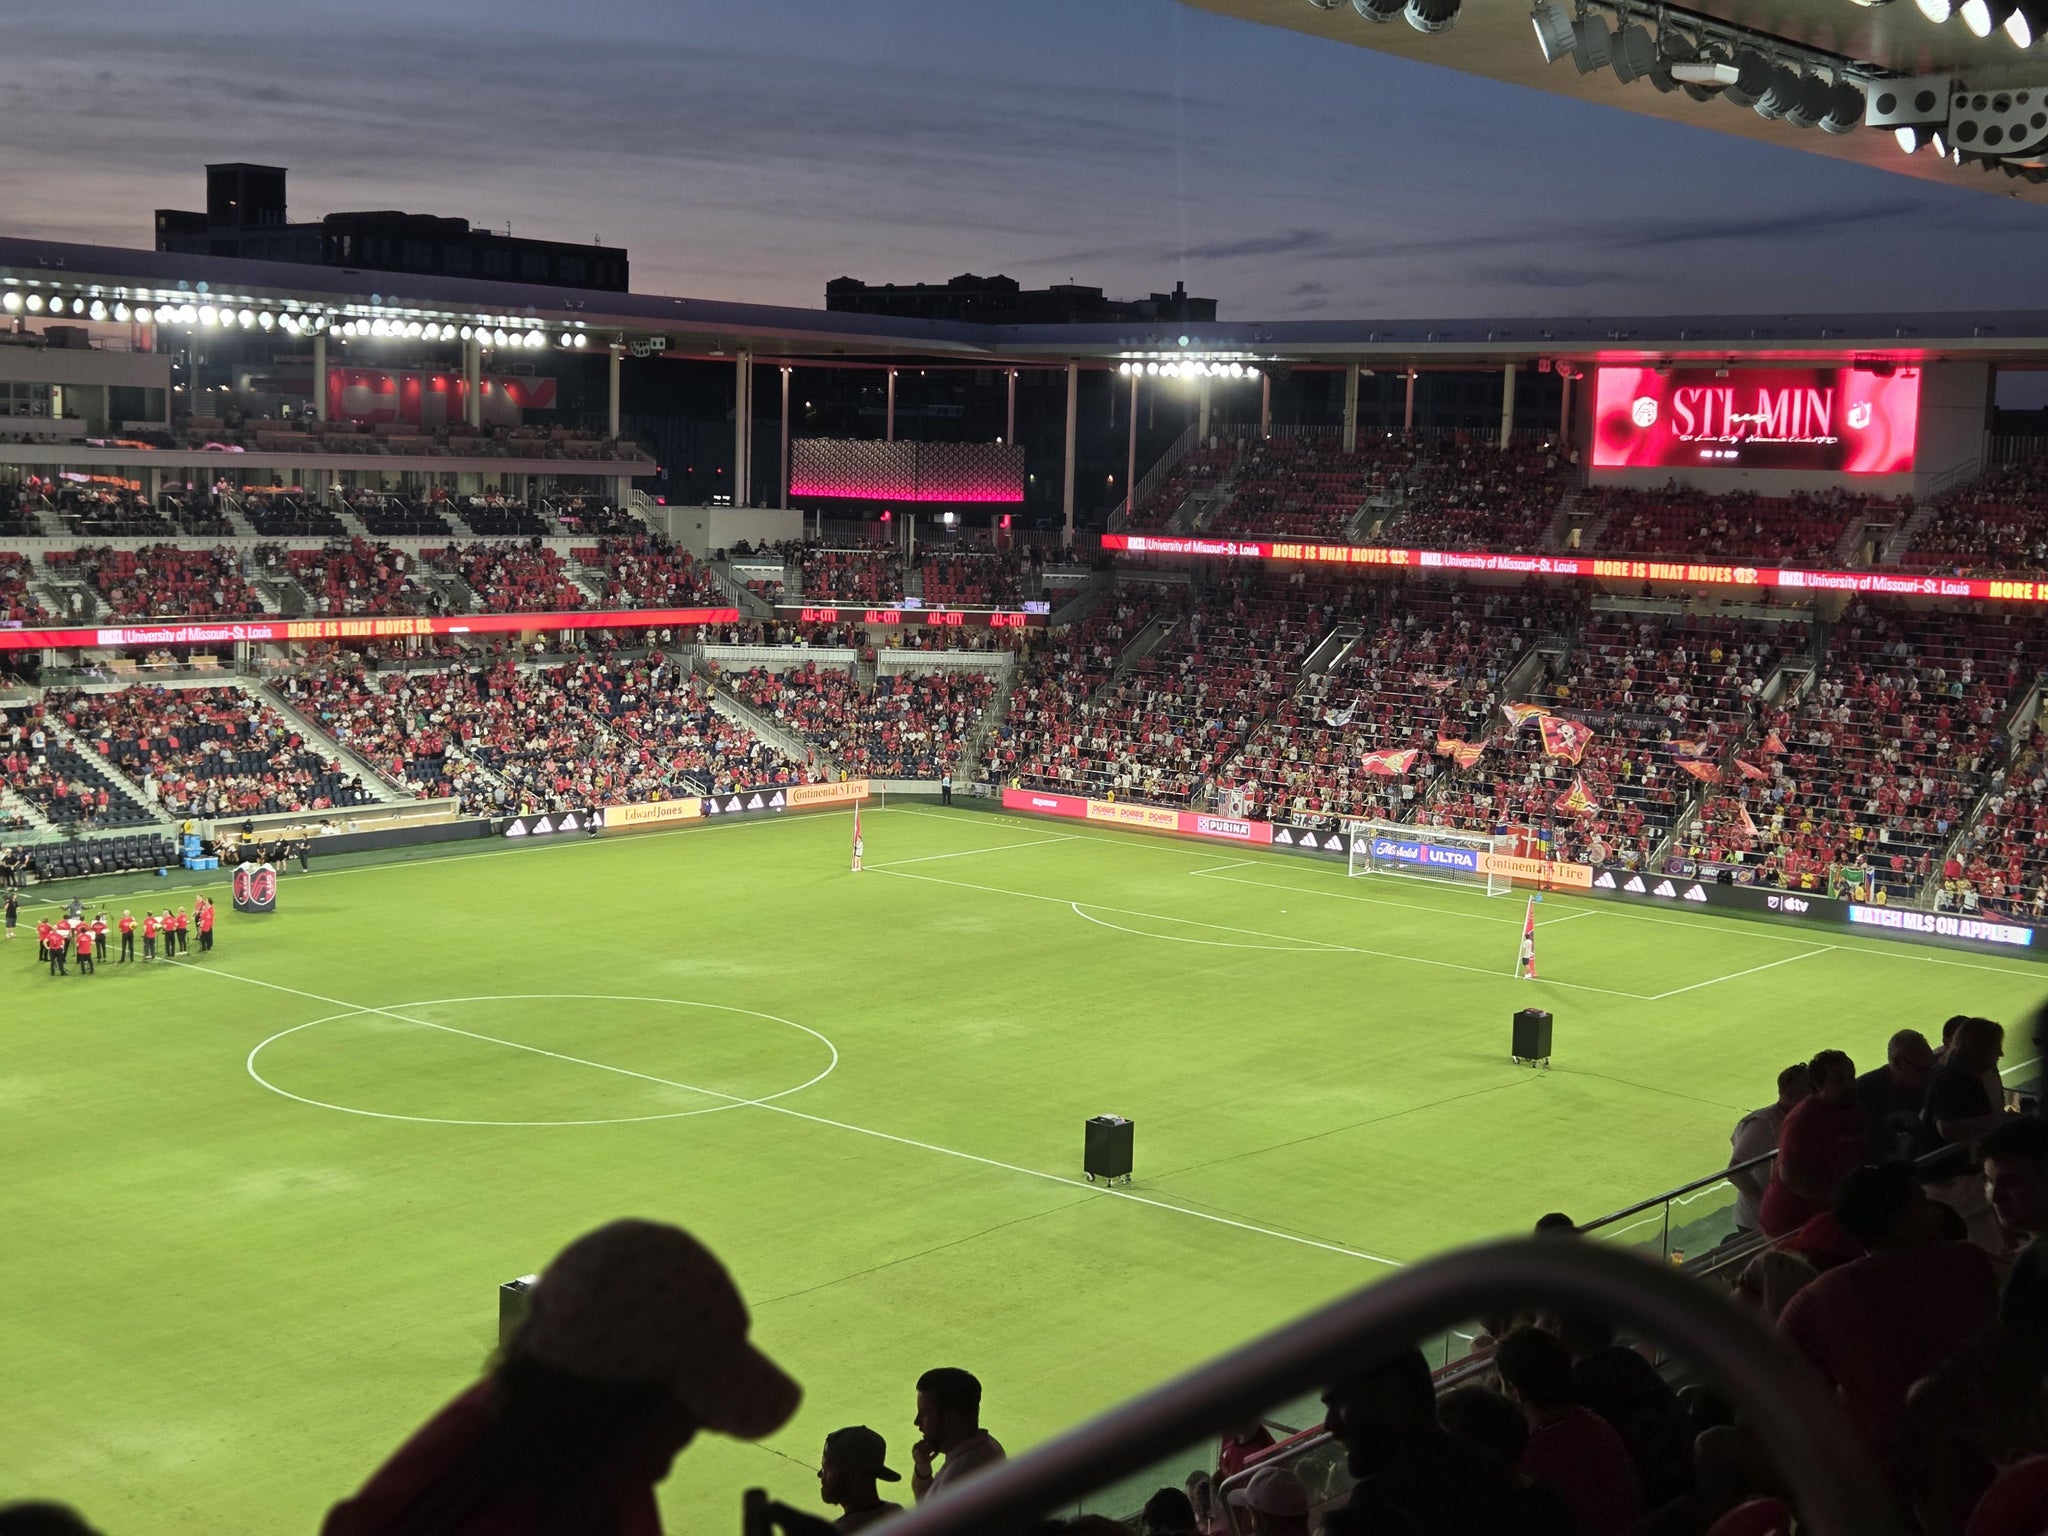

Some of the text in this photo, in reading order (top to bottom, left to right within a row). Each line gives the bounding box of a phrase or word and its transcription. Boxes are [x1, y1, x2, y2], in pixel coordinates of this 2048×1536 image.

[1757, 386, 1836, 436] MIN
[1148, 539, 1182, 552] University
[1184, 541, 1192, 550] of
[1239, 545, 1259, 556] Louis
[1272, 544, 1302, 557] MORE
[1305, 546, 1316, 558] IS
[1319, 546, 1349, 561] WHAT
[1352, 549, 1387, 563] MOVES
[1445, 554, 1486, 569] University
[1487, 557, 1497, 568] of
[1554, 561, 1578, 574] Louis
[1593, 560, 1629, 577] MORE
[1632, 562, 1646, 577] IS
[1650, 564, 1685, 580] WHAT
[1688, 566, 1731, 582] MOVES
[1808, 574, 1857, 589] University
[1860, 576, 1872, 589] of
[1941, 582, 1970, 595] Louis
[1990, 581, 2033, 600] MORE
[127, 628, 175, 643] University
[176, 627, 187, 641] of
[248, 626, 272, 639] Louis
[287, 622, 322, 638] MORE
[325, 622, 338, 636] IS
[341, 620, 373, 636] WHAT
[375, 619, 413, 635] MOVES
[1588, 716, 1606, 727] TIME
[793, 784, 863, 803] Continental Tire
[1208, 821, 1248, 835] PURINA
[1429, 850, 1473, 867] ULTRA
[1558, 865, 1583, 880] Tire
[1853, 906, 1901, 928] WATCH
[1903, 911, 1935, 932] MLS
[1936, 916, 1958, 936] ON
